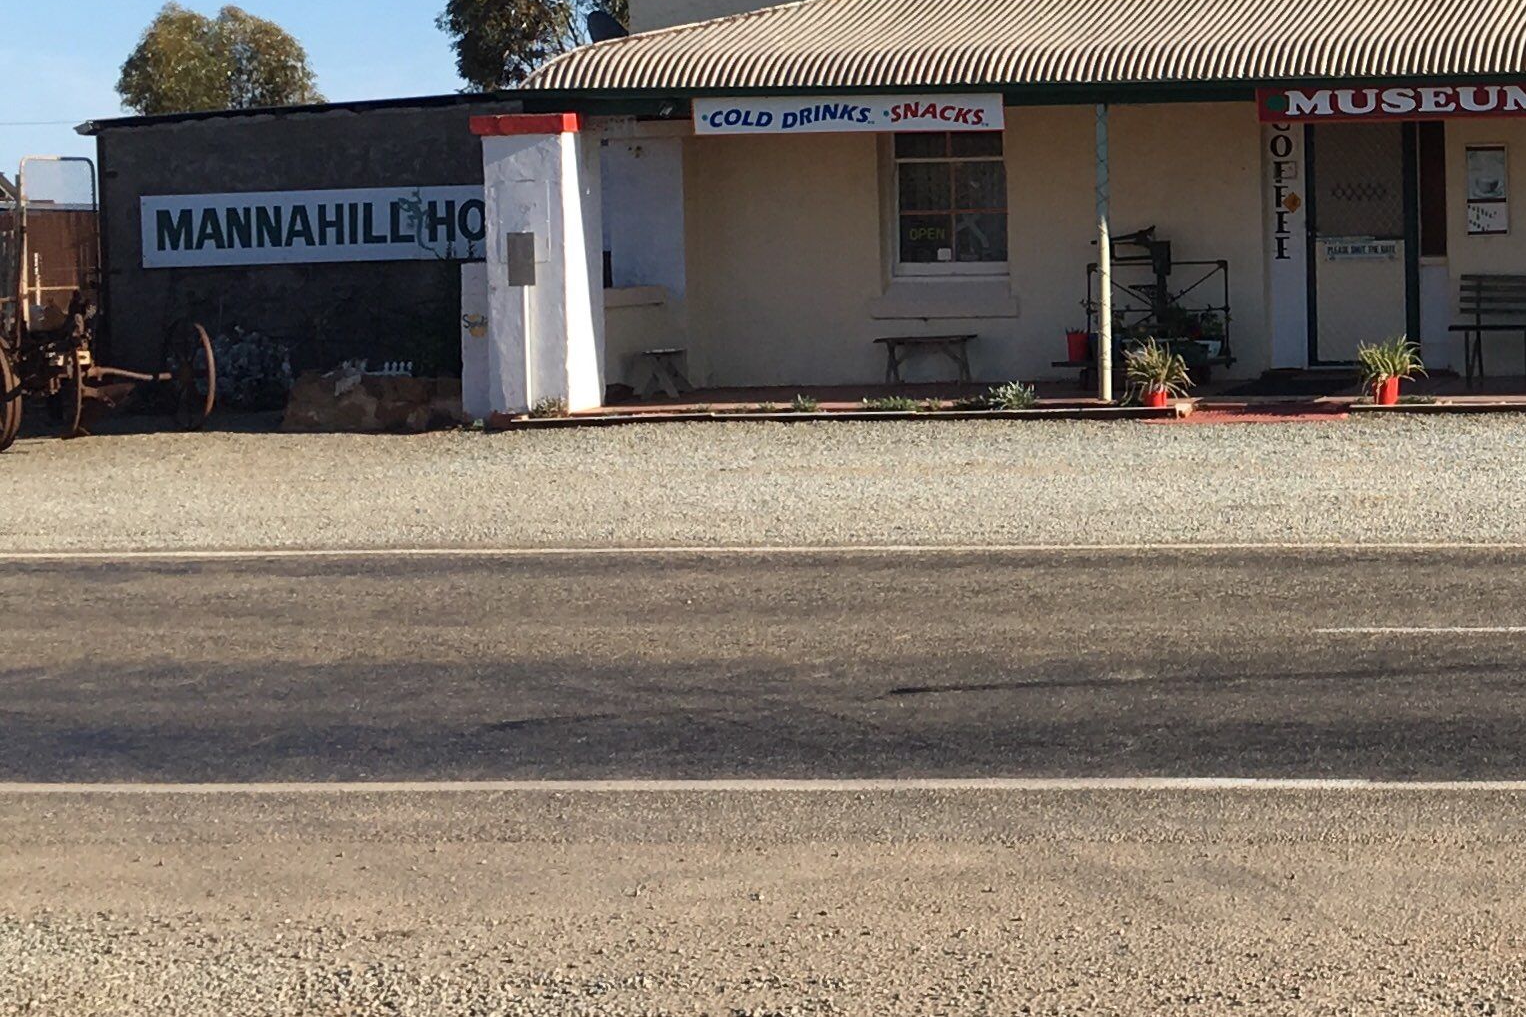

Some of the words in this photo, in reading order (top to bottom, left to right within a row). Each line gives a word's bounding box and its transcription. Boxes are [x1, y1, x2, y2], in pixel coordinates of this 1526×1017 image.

[709, 108, 773, 128] COLD
[781, 103, 871, 129] DRINKS
[890, 101, 984, 125] SNACKS
[156, 201, 416, 252] MANNAHILL
[909, 227, 945, 241] OPEN
